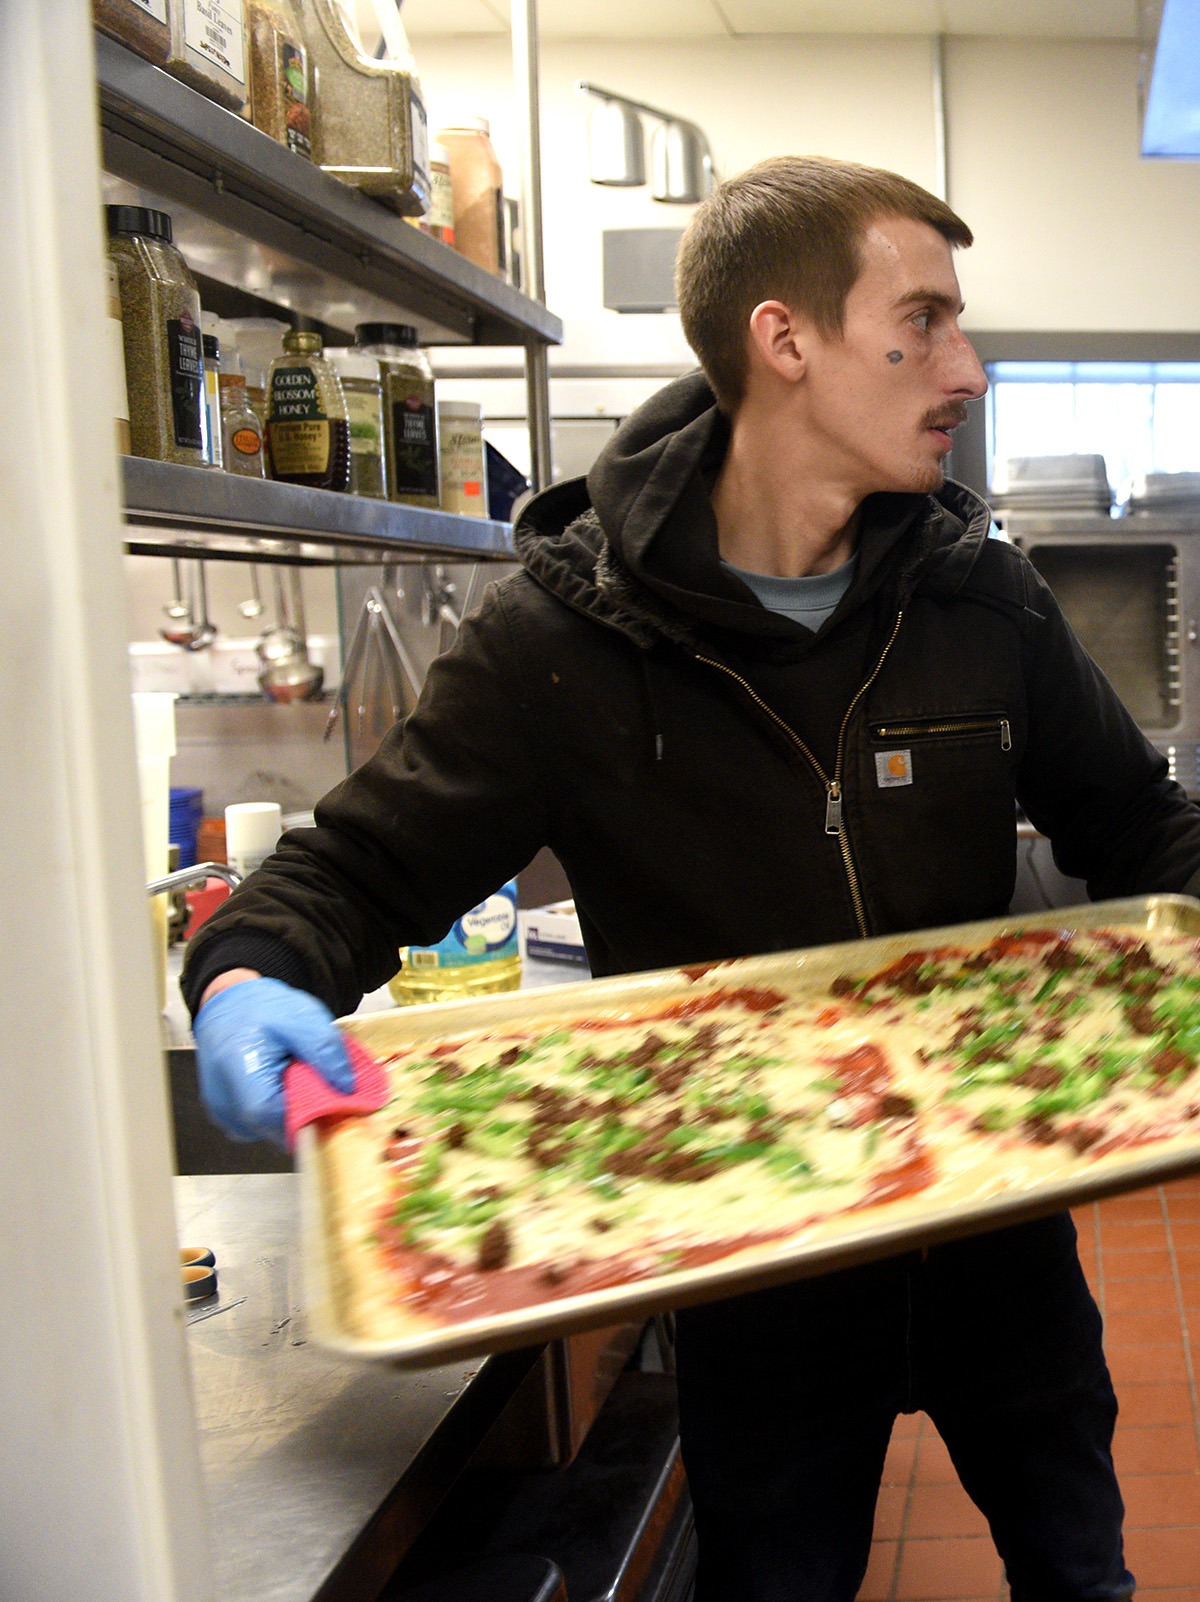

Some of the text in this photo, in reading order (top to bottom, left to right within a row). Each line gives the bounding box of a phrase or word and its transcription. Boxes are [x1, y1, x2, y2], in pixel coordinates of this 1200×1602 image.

[197, 0, 213, 20] Basil
[214, 13, 233, 35] Leaves
[179, 342, 198, 360] THYME
[274, 374, 311, 386] GOLDEN
[273, 389, 315, 401] BLOSSOM
[278, 404, 311, 415] HONEY
[466, 912, 509, 928] Vegetable
